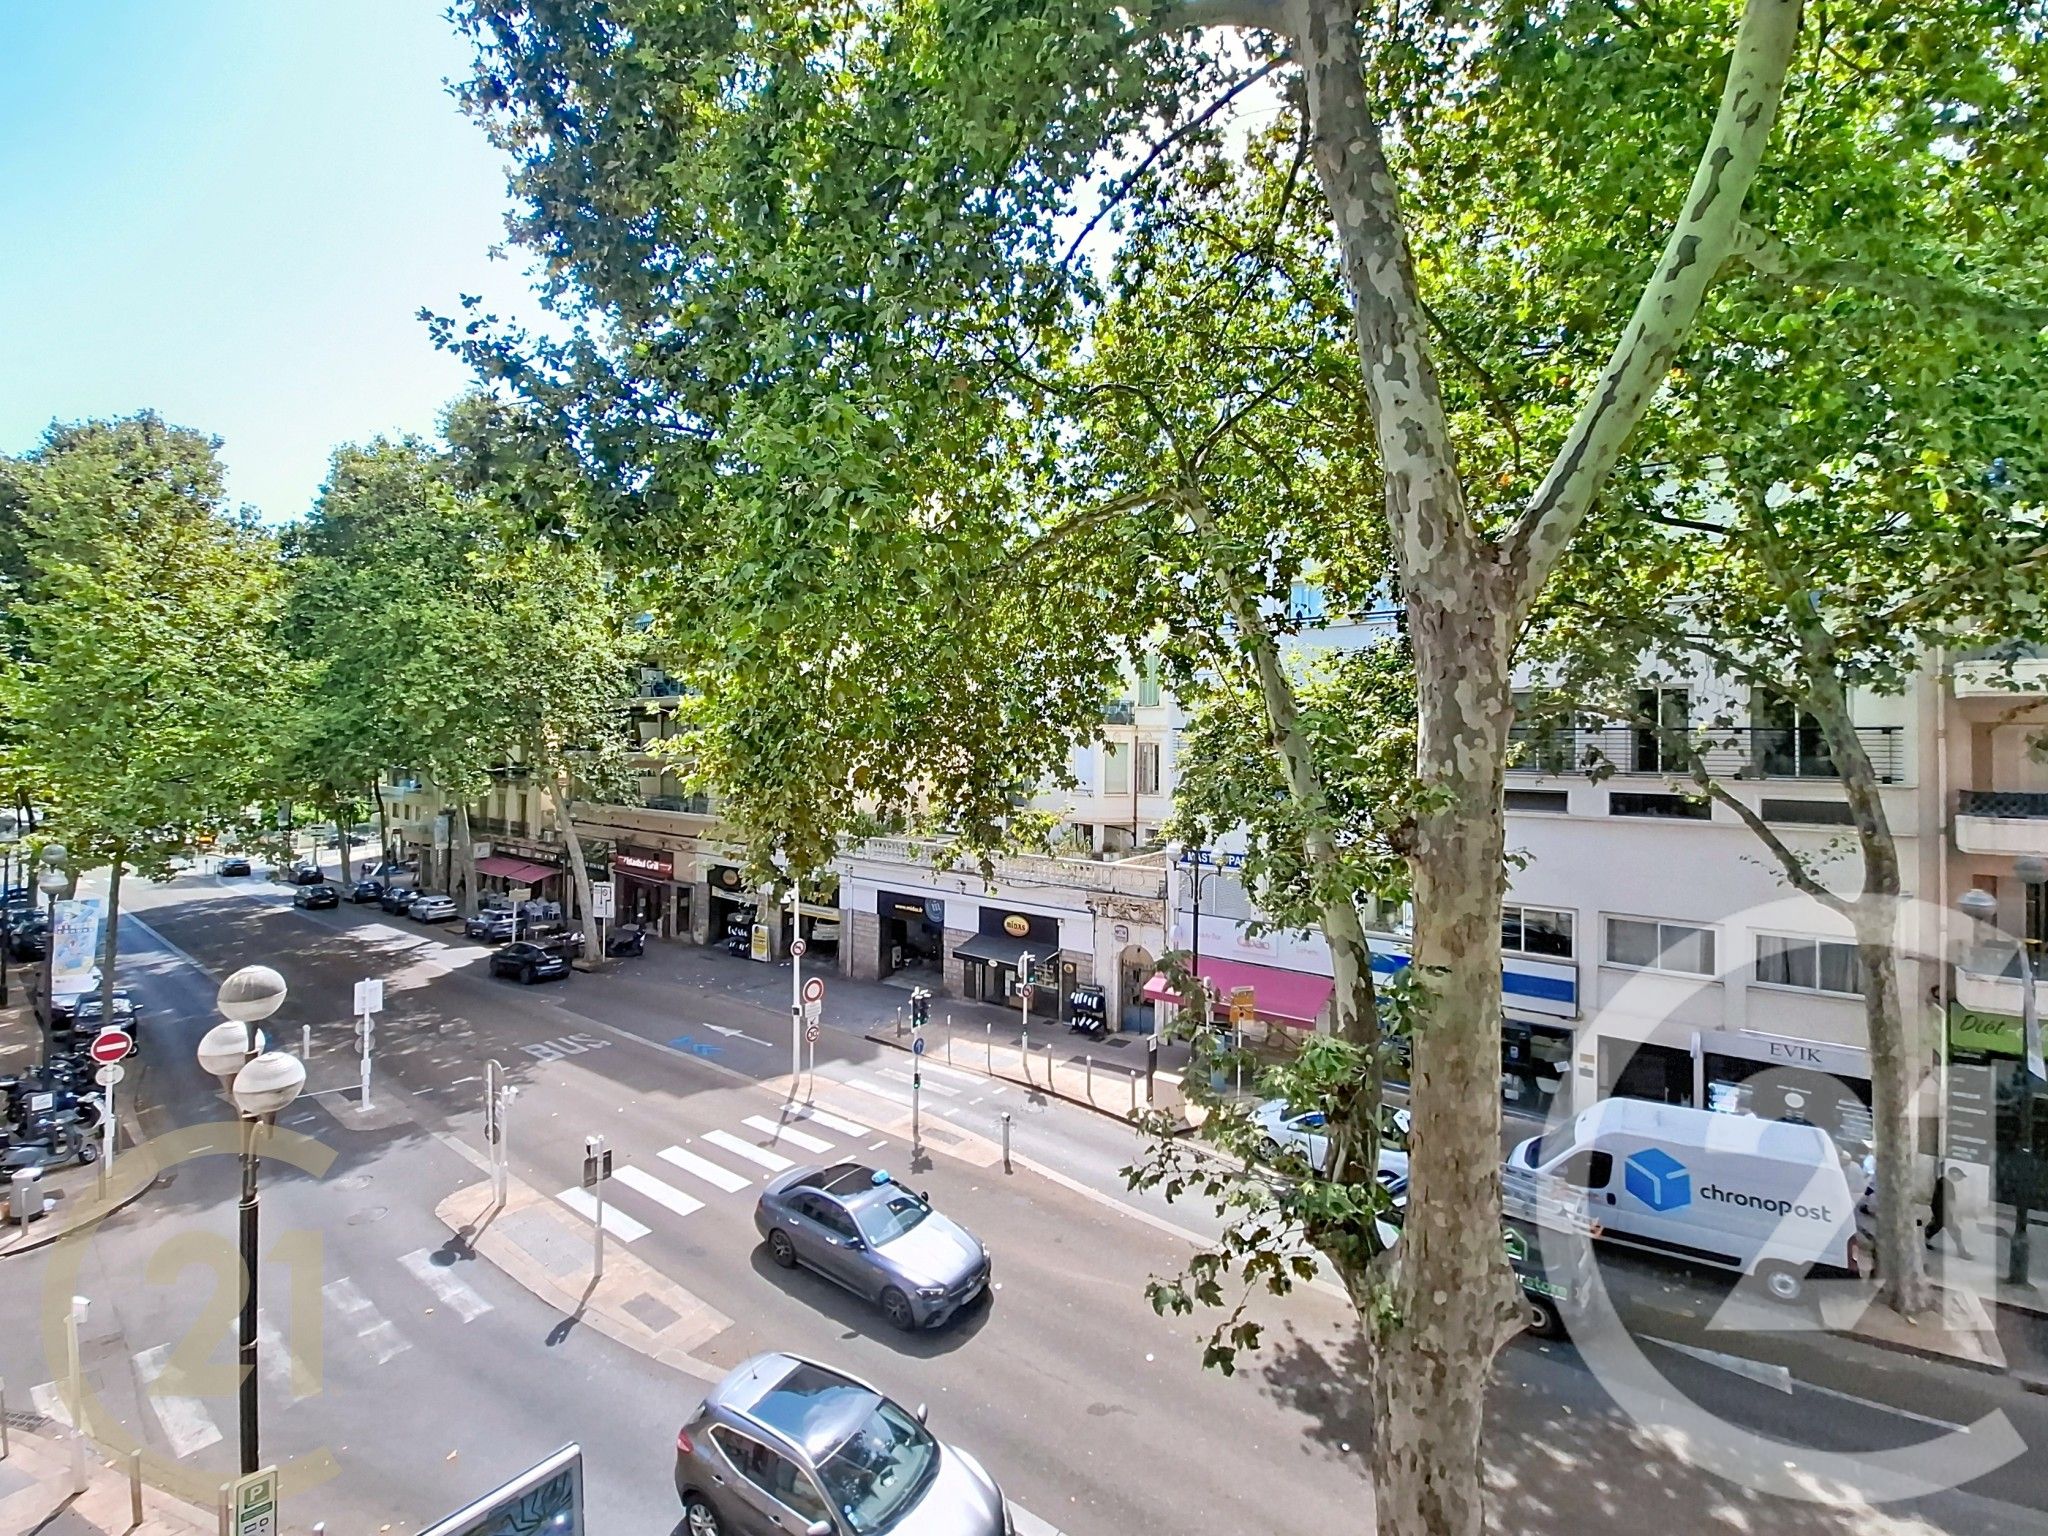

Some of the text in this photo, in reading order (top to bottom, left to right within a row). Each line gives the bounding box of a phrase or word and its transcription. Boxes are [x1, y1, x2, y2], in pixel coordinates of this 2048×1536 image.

[519, 1033, 612, 1062] BUS
[1769, 1042, 1822, 1063] EVIK
[1700, 1184, 1832, 1222] chronopost
